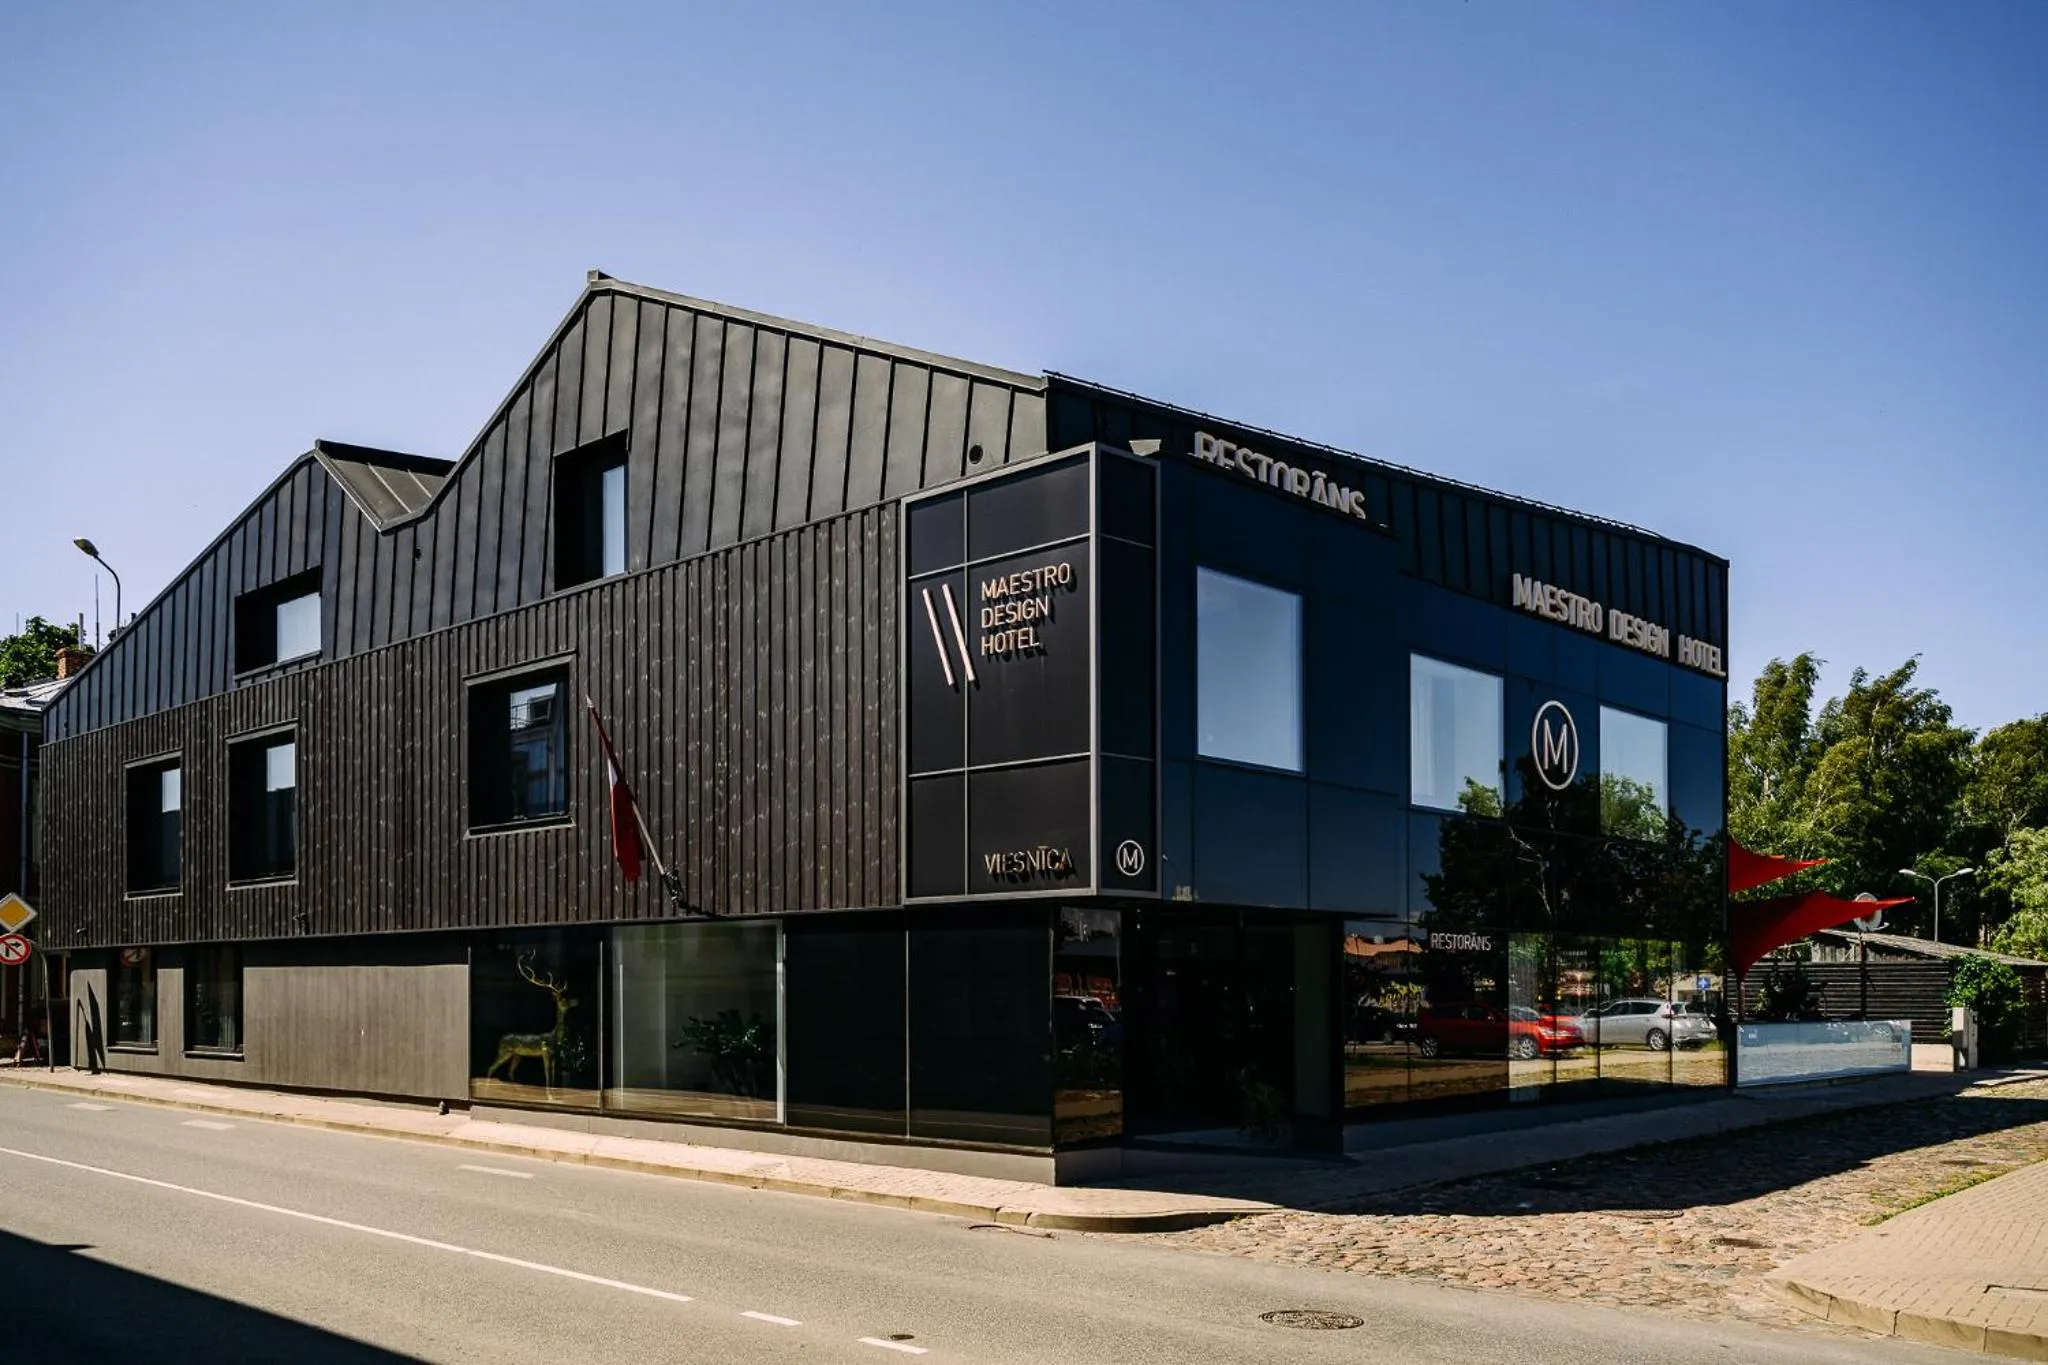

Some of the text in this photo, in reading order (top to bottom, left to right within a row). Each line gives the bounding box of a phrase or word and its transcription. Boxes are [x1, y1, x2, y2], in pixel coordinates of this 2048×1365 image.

[981, 562, 1070, 601] MAESTRO
[981, 595, 1048, 628] DESIGN
[1513, 573, 1726, 677] MAESTRO DESIGN HOTEL
[981, 626, 1040, 656] HOTEL
[1543, 718, 1568, 774] M
[984, 845, 1073, 874] VIESNĪCA
[1122, 847, 1138, 870] M
[1430, 932, 1492, 951] RESTORĀNS
